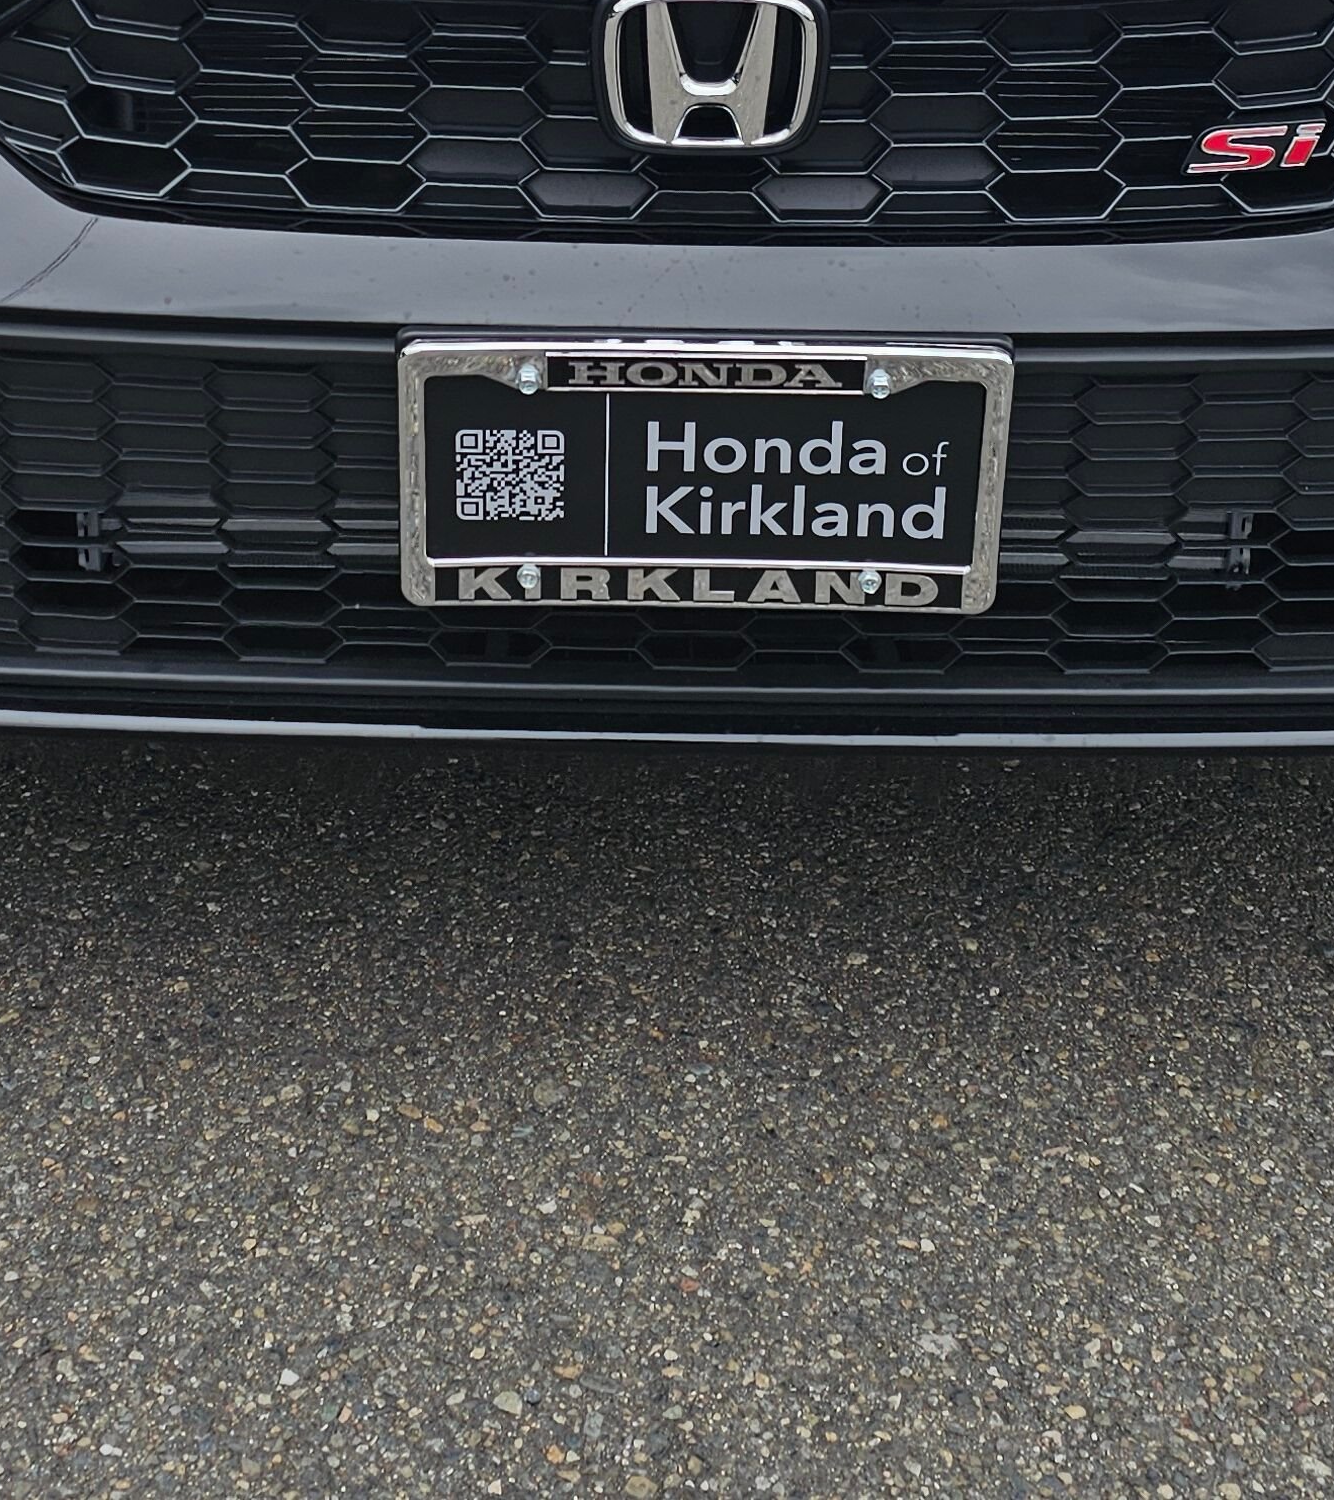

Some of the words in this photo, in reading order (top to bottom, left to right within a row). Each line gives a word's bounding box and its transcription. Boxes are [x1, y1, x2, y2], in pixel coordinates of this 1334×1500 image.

[1186, 123, 1326, 173] Si
[568, 360, 842, 388] HONDA
[646, 421, 886, 476] Honda
[902, 442, 948, 477] of
[645, 484, 946, 540] Kirkland
